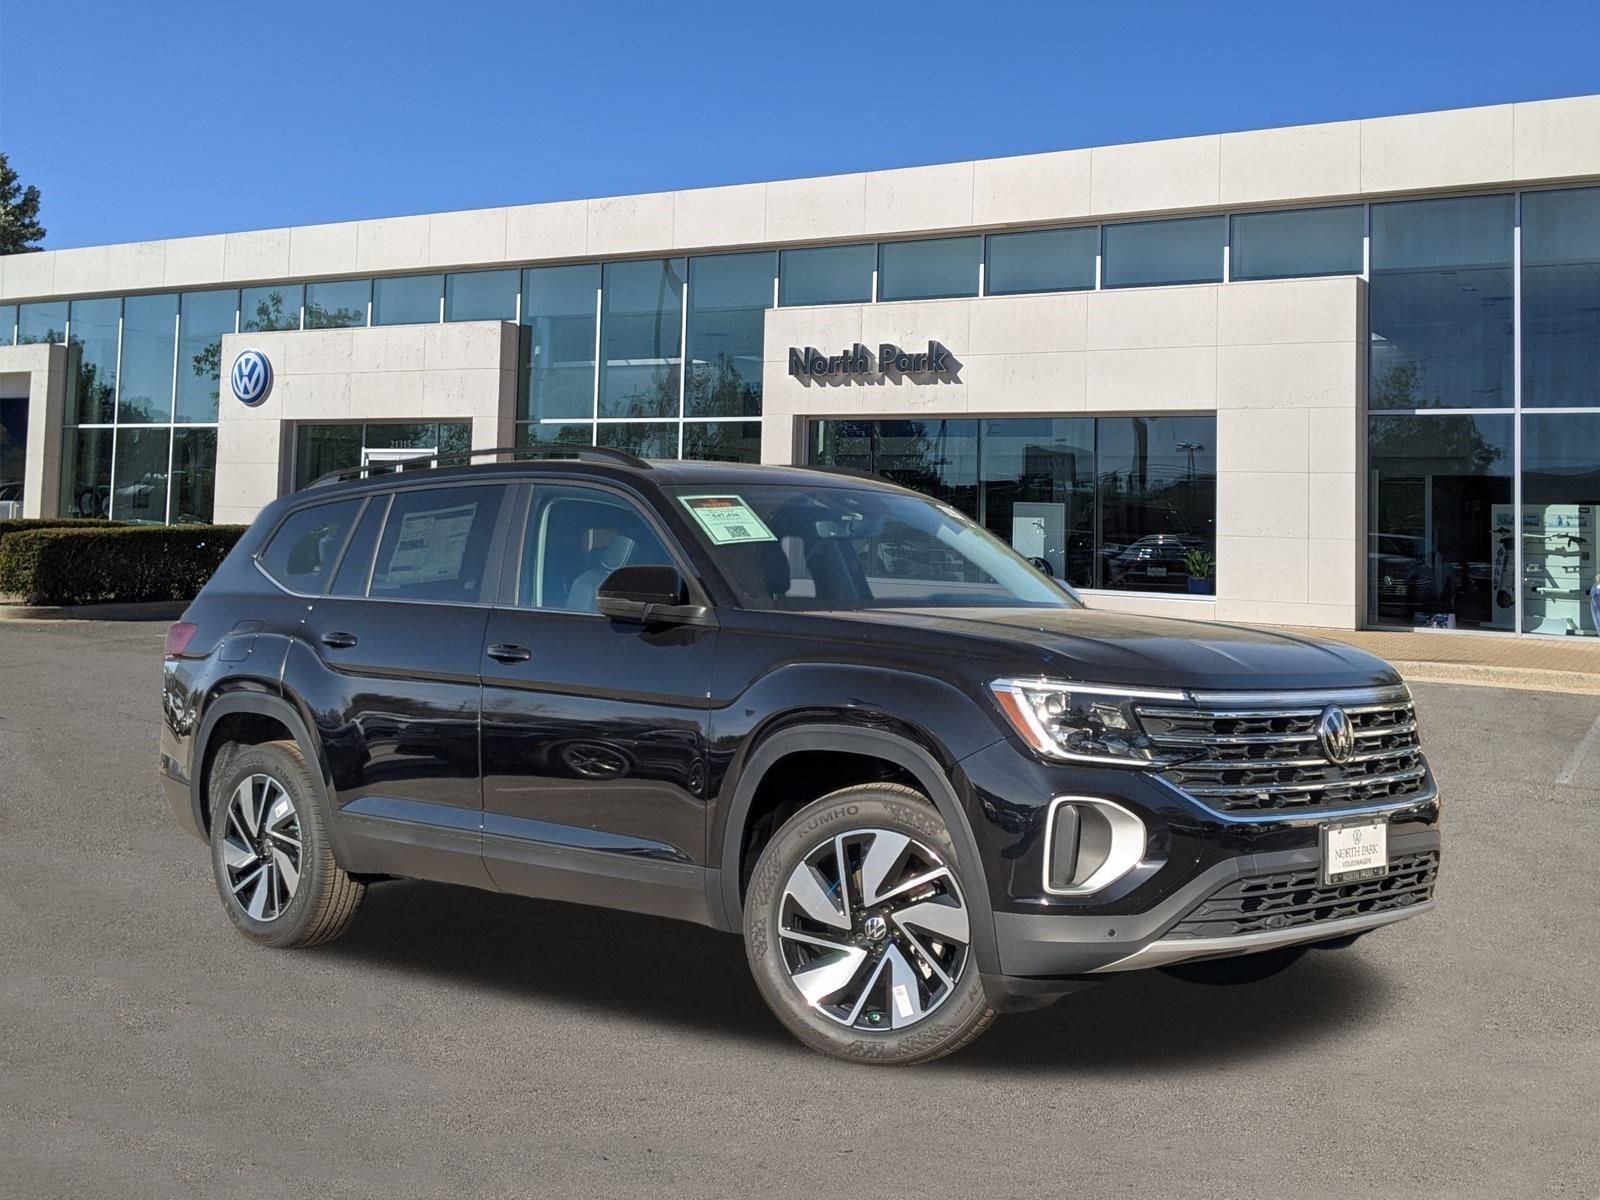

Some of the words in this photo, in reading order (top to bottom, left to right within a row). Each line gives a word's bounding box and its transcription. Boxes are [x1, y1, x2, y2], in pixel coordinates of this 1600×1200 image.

[788, 343, 873, 376] North
[878, 340, 948, 373] Park
[1335, 847, 1360, 860] NORTH
[1361, 844, 1379, 856] PARK
